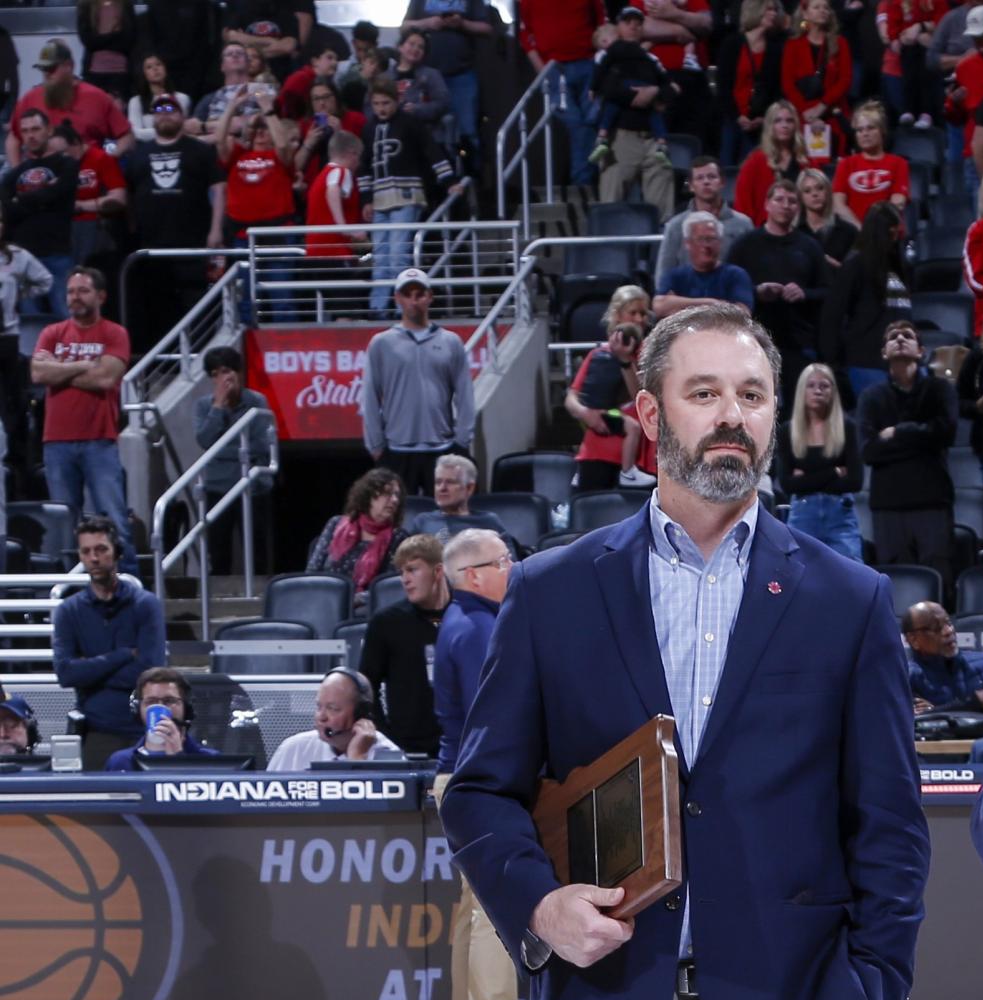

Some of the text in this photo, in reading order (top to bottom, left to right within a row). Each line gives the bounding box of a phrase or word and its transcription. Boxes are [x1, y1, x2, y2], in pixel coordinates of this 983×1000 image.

[264, 351, 332, 373] BOYS
[930, 769, 975, 780] BOLD
[155, 782, 287, 802] INDIANA
[288, 781, 318, 791] FOR
[321, 781, 406, 800] BOLD
[288, 790, 318, 800] THE
